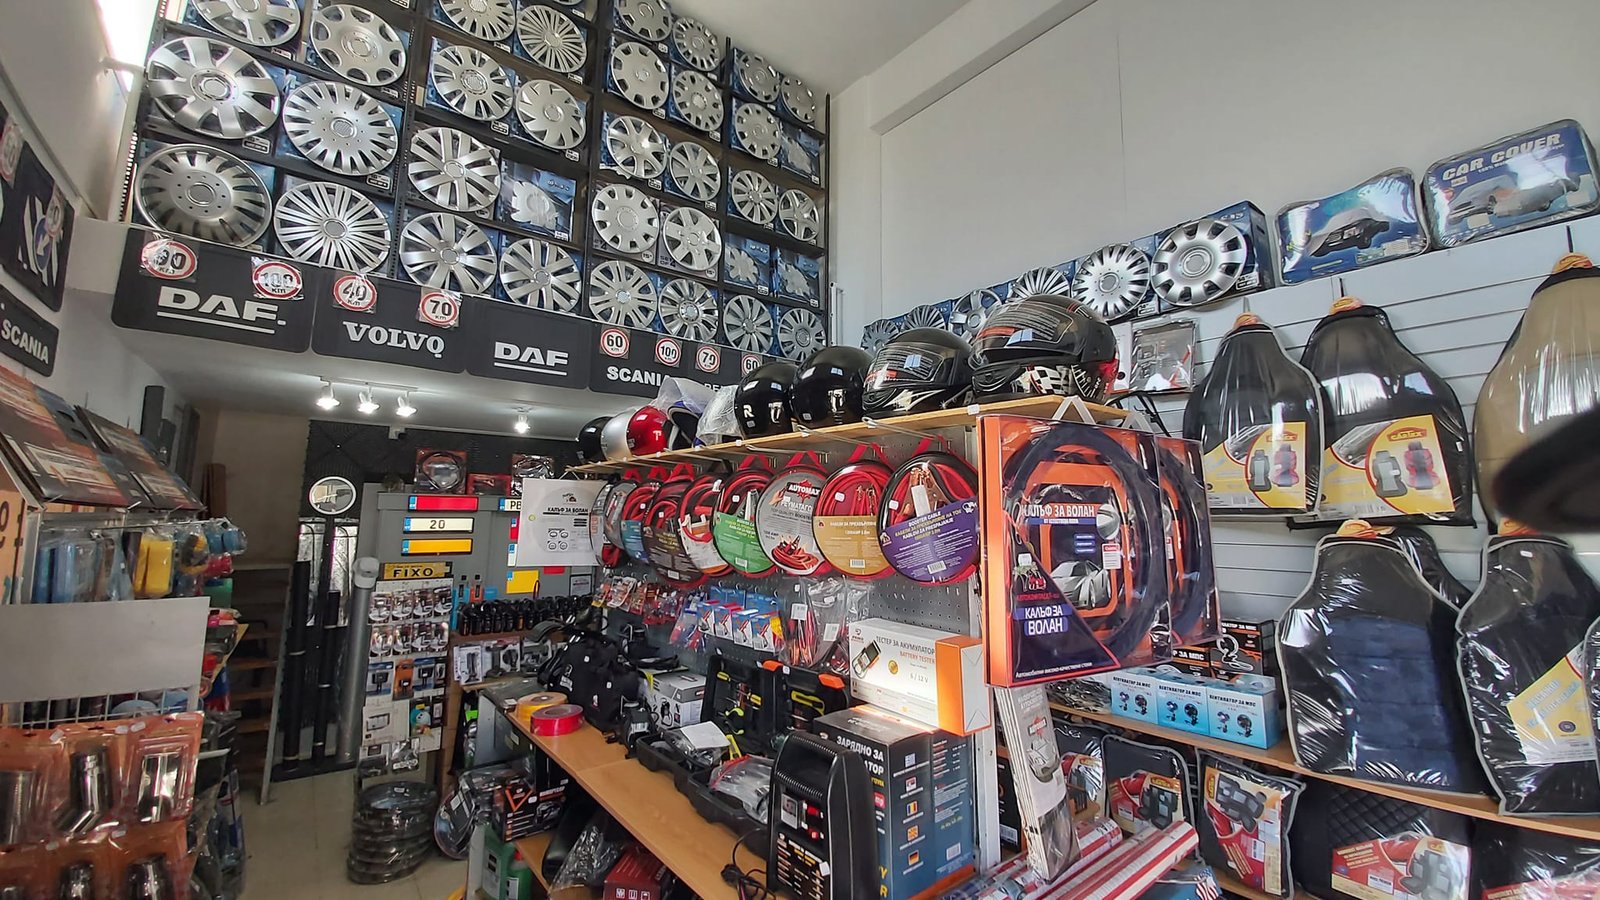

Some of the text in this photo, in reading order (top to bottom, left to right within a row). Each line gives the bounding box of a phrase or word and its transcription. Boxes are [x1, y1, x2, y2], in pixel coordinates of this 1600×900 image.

[1442, 133, 1560, 180] CAR COVER
[158, 286, 279, 321] DAF
[429, 299, 453, 317] 70
[1, 318, 49, 365] SCANIA
[343, 321, 445, 354] VOLVO
[606, 334, 624, 349] 60
[494, 341, 568, 367] DAF
[660, 345, 677, 359] 100
[1054, 505, 1066, 517] ЗА
[1066, 505, 1095, 518] ВОЛАН
[429, 519, 446, 529] 20
[393, 567, 433, 578] FIXO
[1025, 604, 1064, 619] КАЛЪФ ЗА
[1028, 617, 1063, 636] ВОЛАН
[876, 636, 892, 645] ТЕСТЕР
[900, 642, 935, 655] АКУМУЛАТОР
[1178, 650, 1188, 658] ЗА
[836, 735, 884, 762] ЗАРЯДНО ЗА
